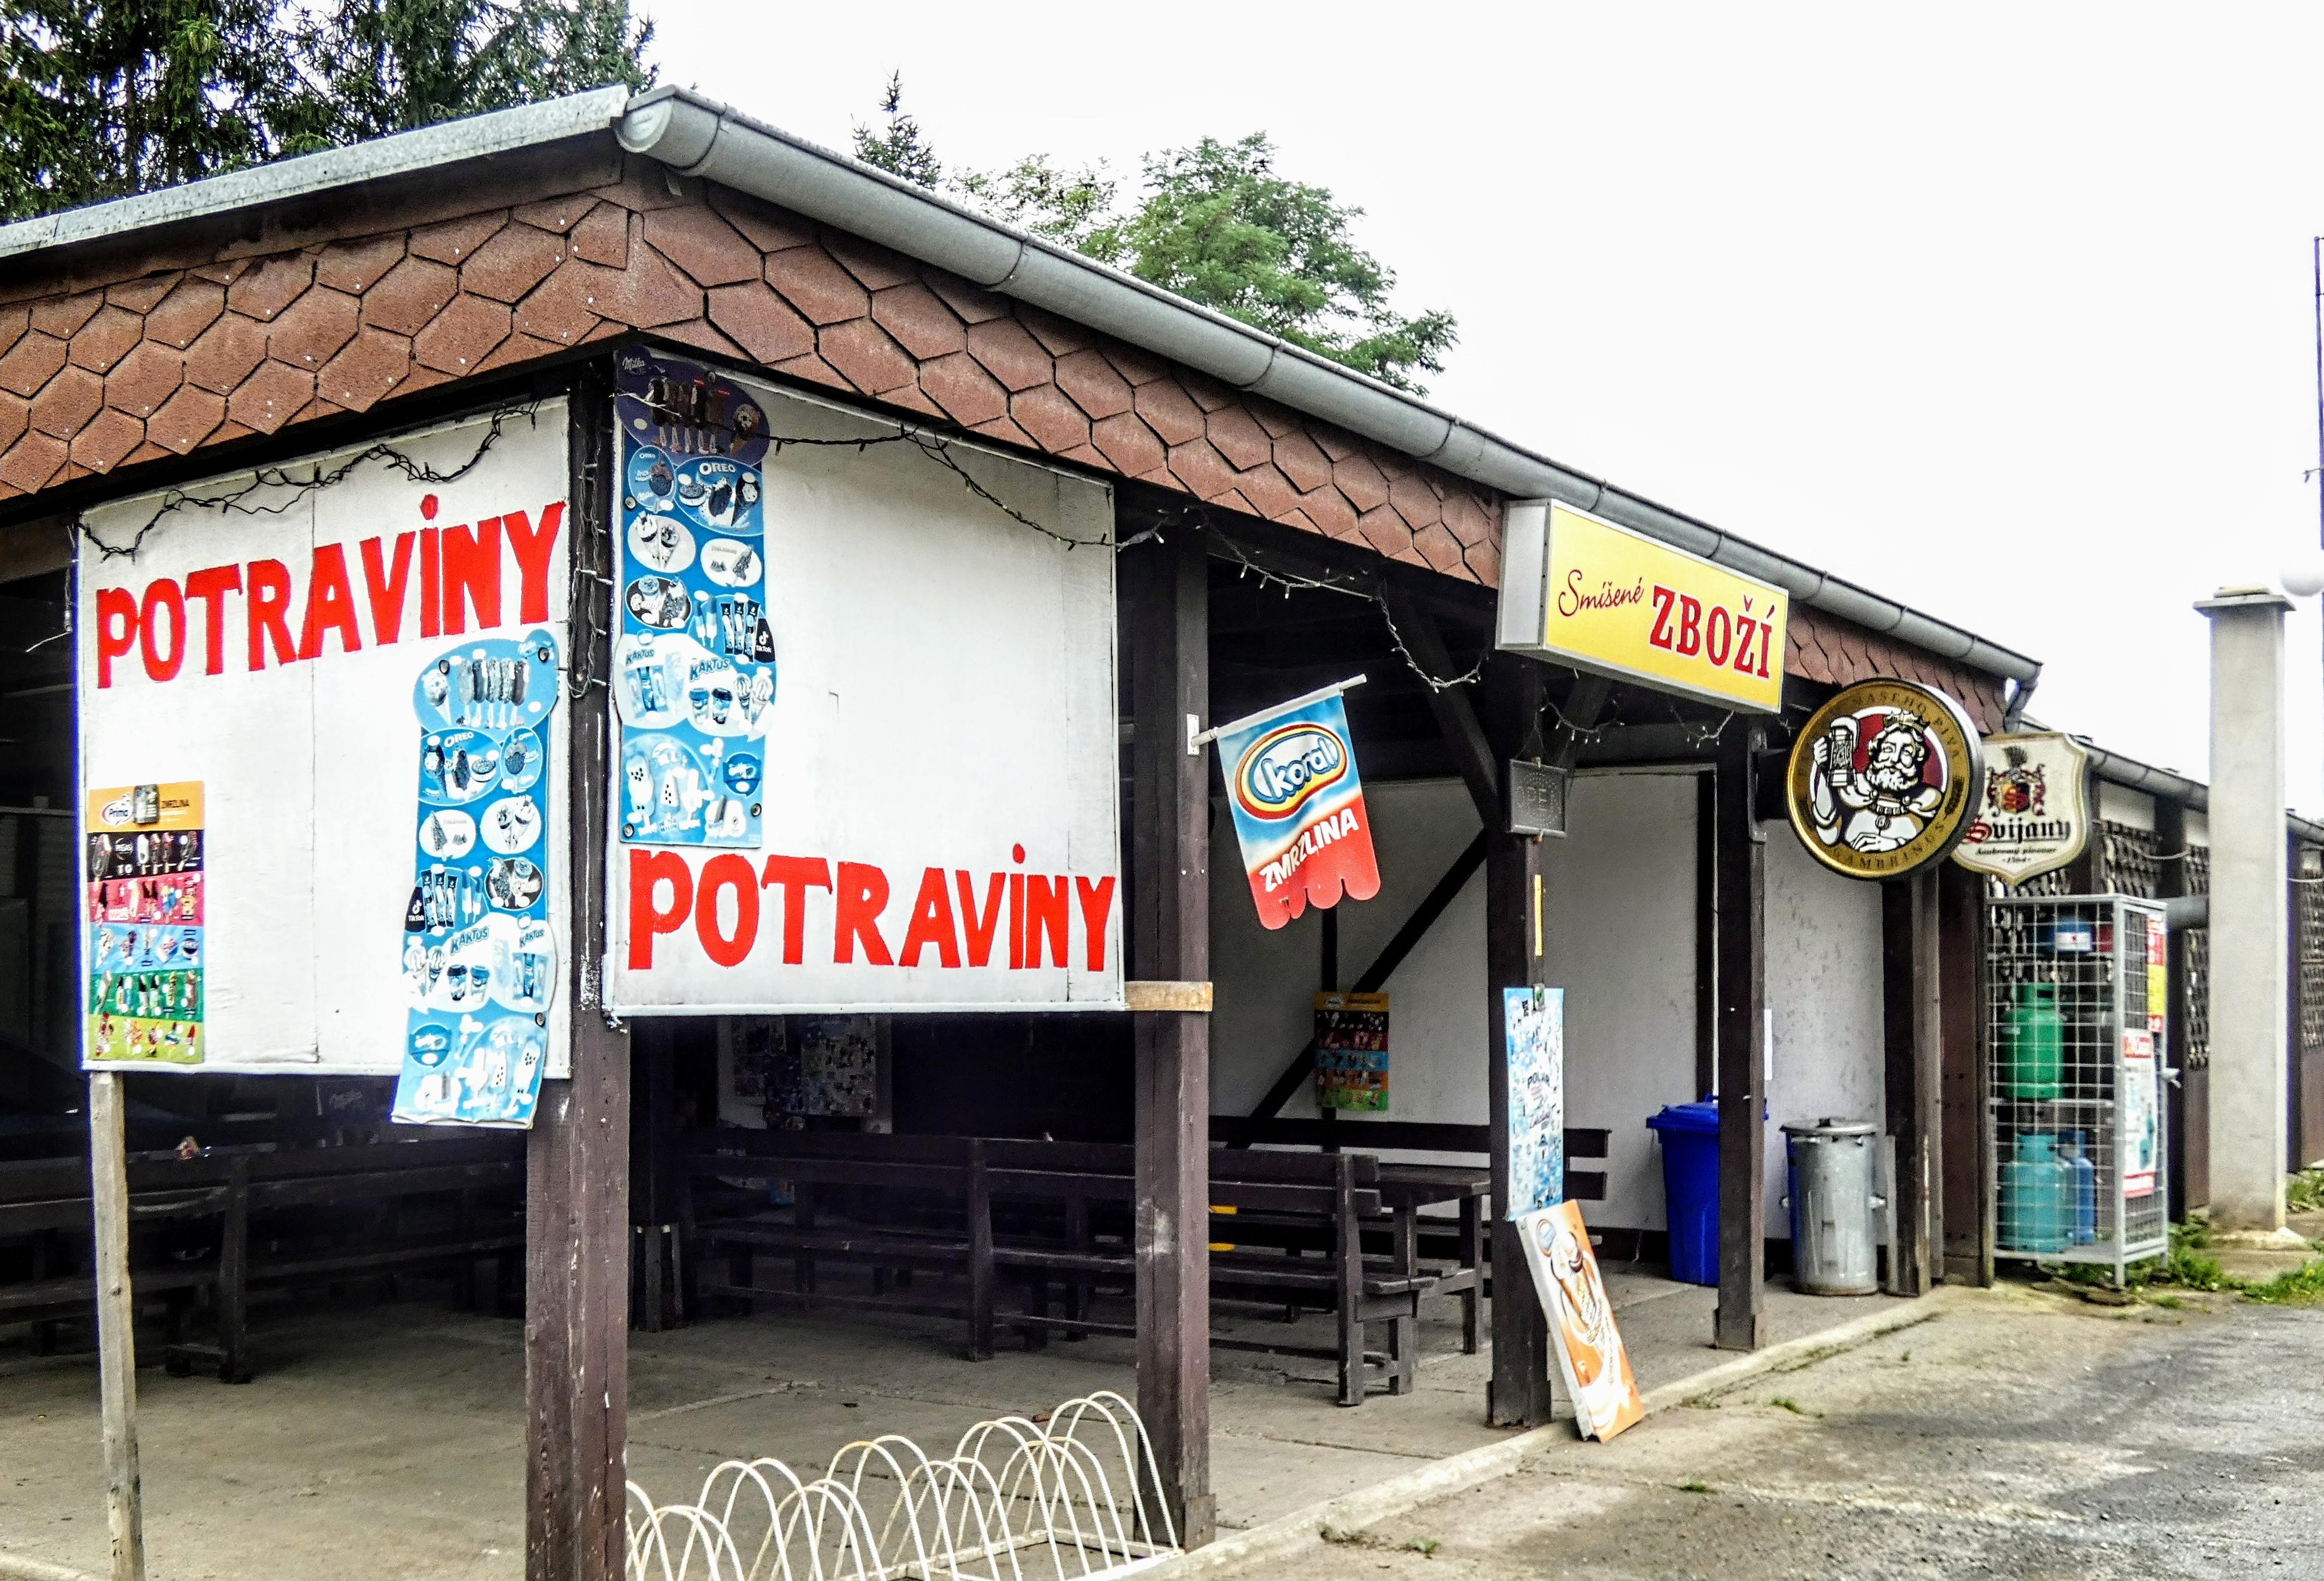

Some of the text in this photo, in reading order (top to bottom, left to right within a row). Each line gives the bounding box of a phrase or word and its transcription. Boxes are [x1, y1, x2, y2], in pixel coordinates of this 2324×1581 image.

[699, 462, 736, 475] OREO
[1558, 569, 1644, 617] Smíšené
[1649, 585, 1776, 679] ZBOŽÍ
[626, 649, 654, 666] KAKTUS
[689, 657, 730, 682] KAKTUS
[444, 732, 474, 748] OREO
[1259, 808, 1360, 892] ZMRZLINA
[450, 926, 489, 955] KAKTUS
[519, 928, 545, 948] KAKTUS
